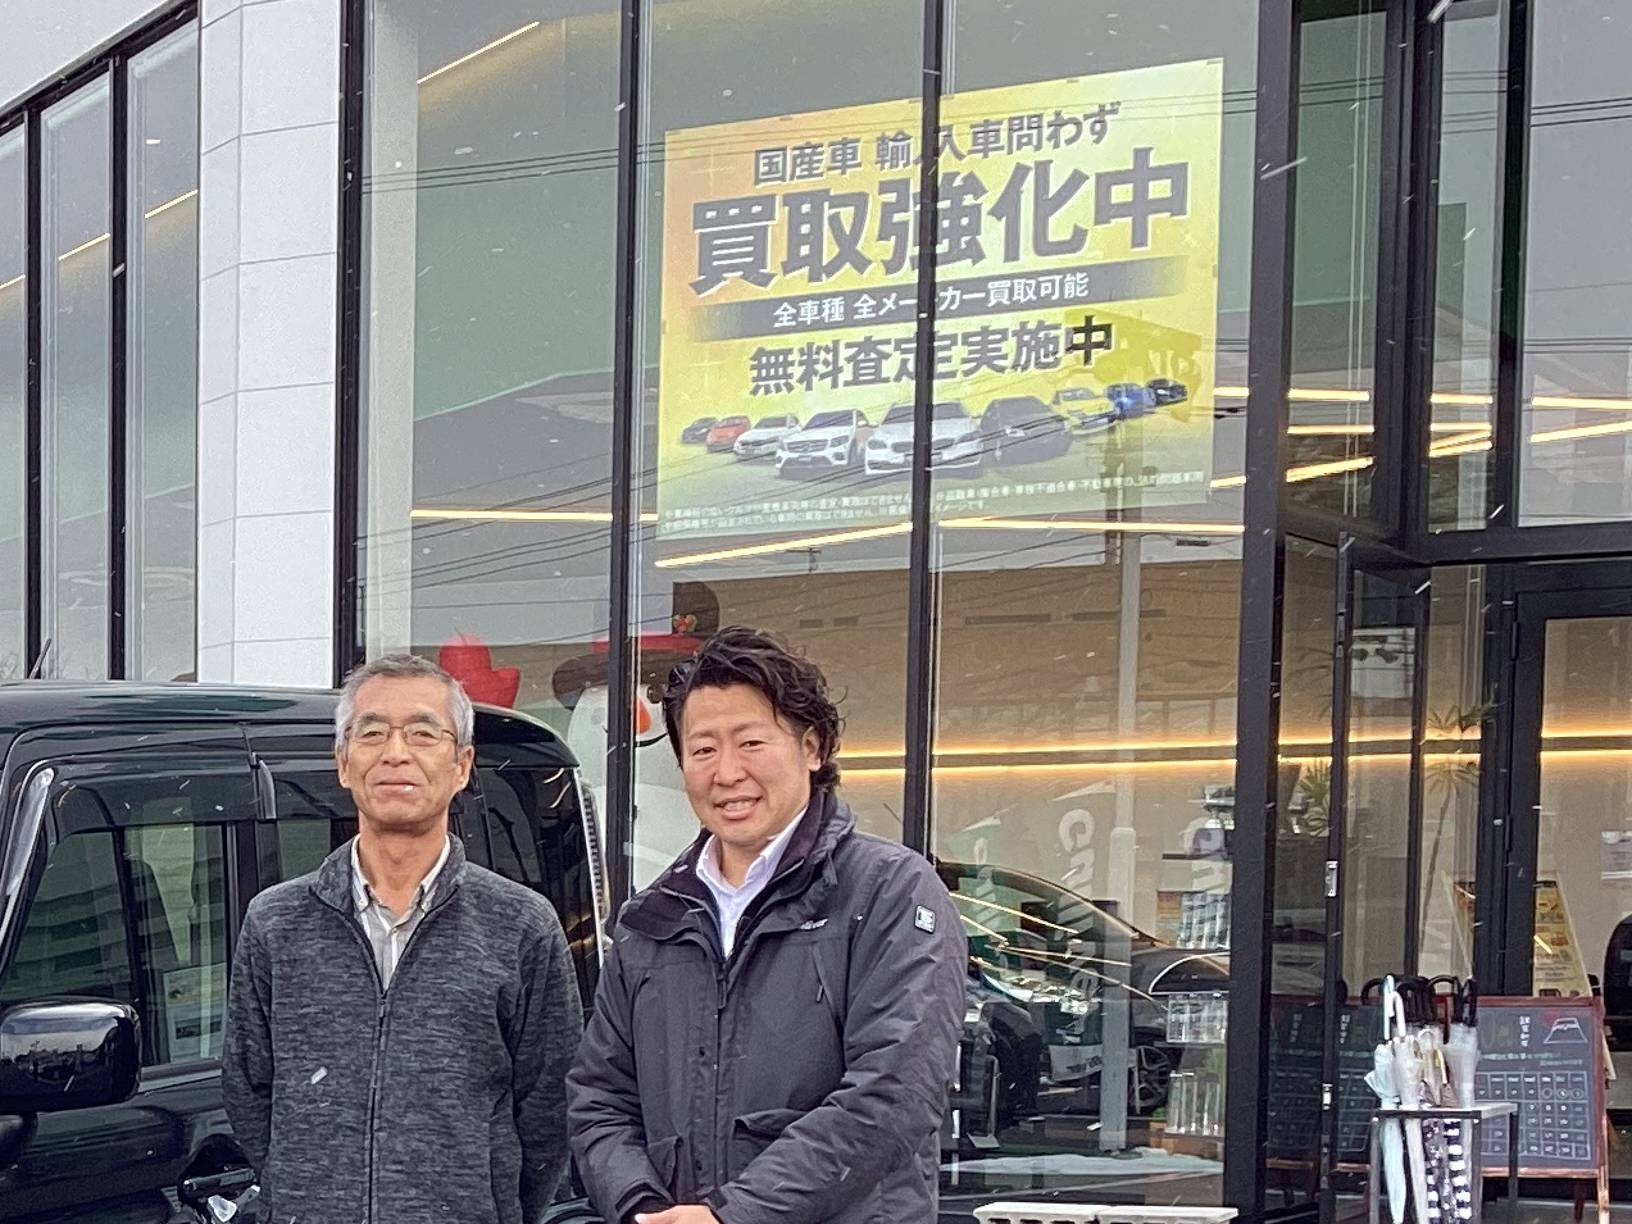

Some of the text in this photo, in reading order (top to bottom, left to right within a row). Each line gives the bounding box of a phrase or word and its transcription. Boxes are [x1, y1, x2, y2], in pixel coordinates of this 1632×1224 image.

[754, 101, 1122, 184] 国産車 輸入車問わず
[689, 146, 1190, 295] 買取強化中
[772, 272, 1089, 328] 全車種 全メーカー買取可能
[748, 314, 1113, 396] 無料査定実施中
